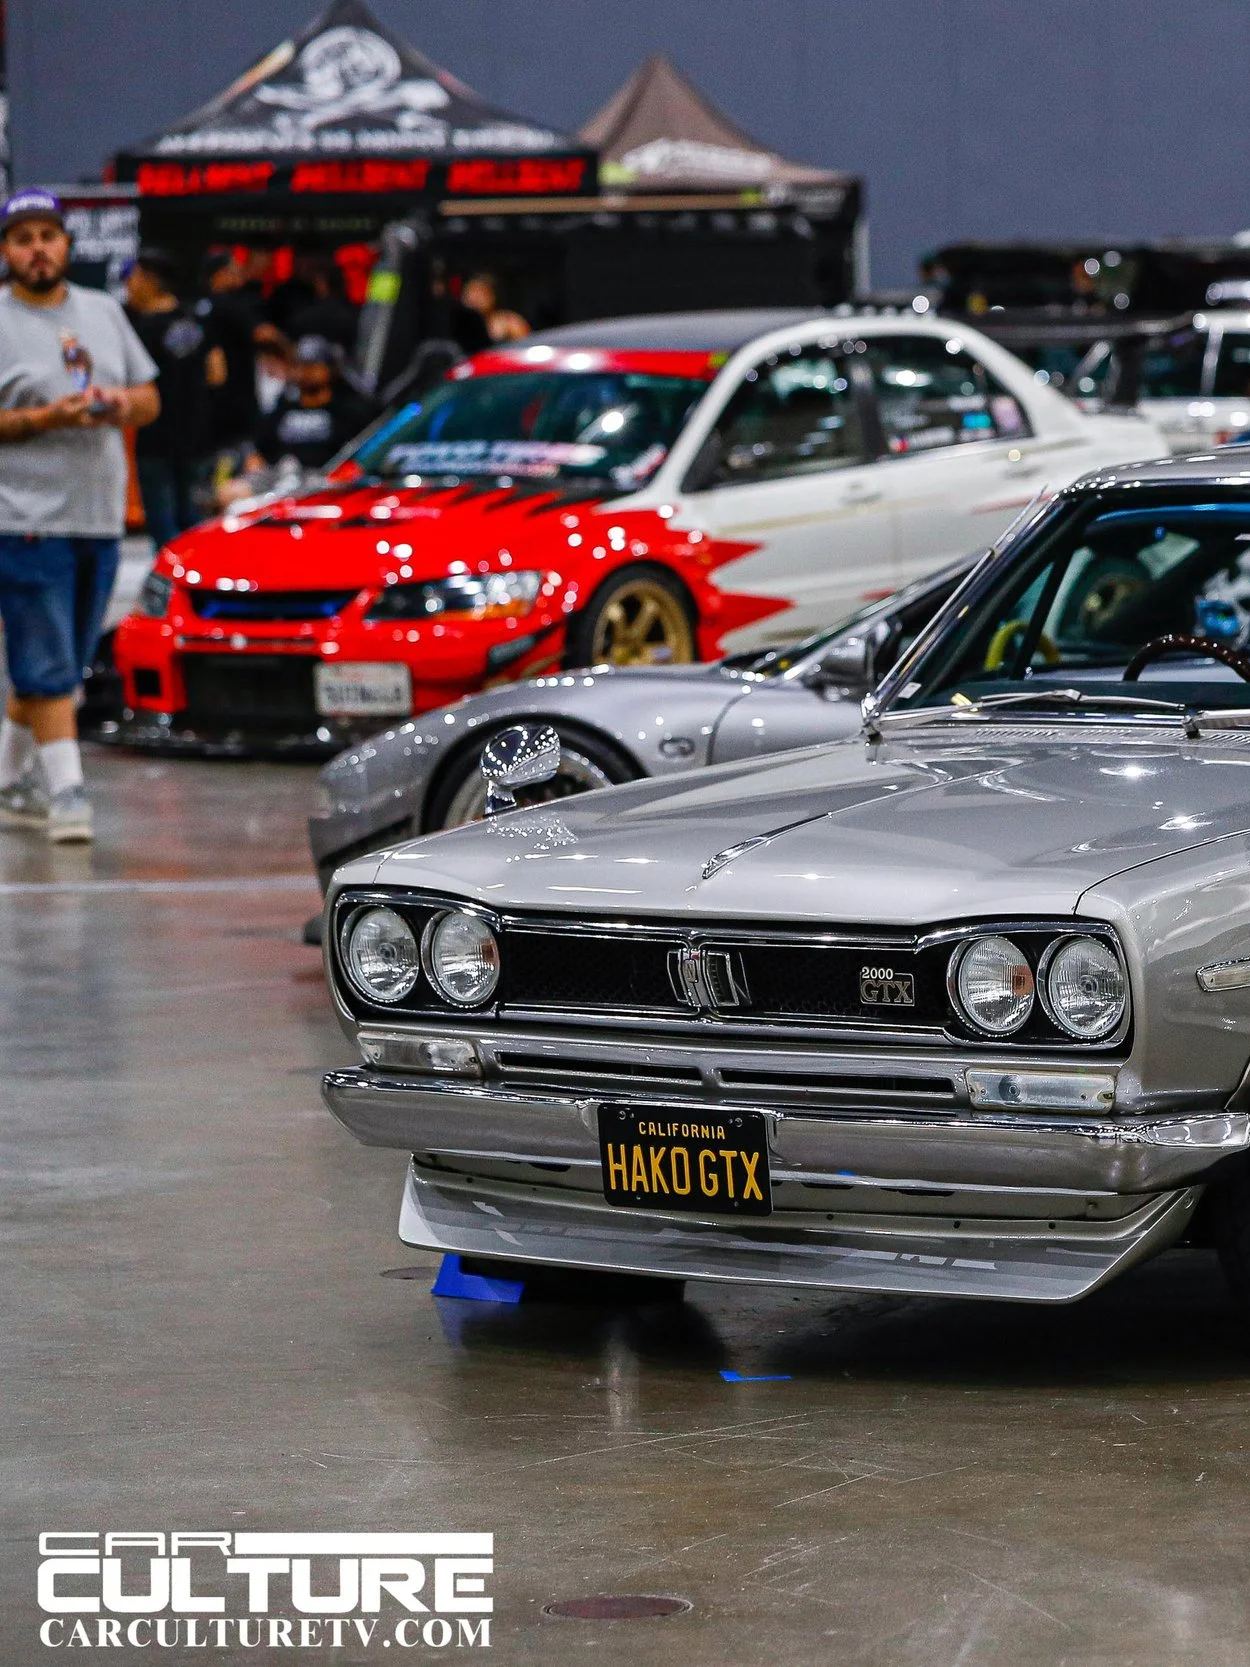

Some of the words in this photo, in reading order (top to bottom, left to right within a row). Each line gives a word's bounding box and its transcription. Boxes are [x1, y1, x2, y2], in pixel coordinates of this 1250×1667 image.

[861, 967, 893, 980] 2000
[860, 979, 913, 1004] GTX
[638, 1121, 726, 1140] CALIFORNIA
[607, 1143, 691, 1195] HAKO
[698, 1149, 764, 1201] GTX
